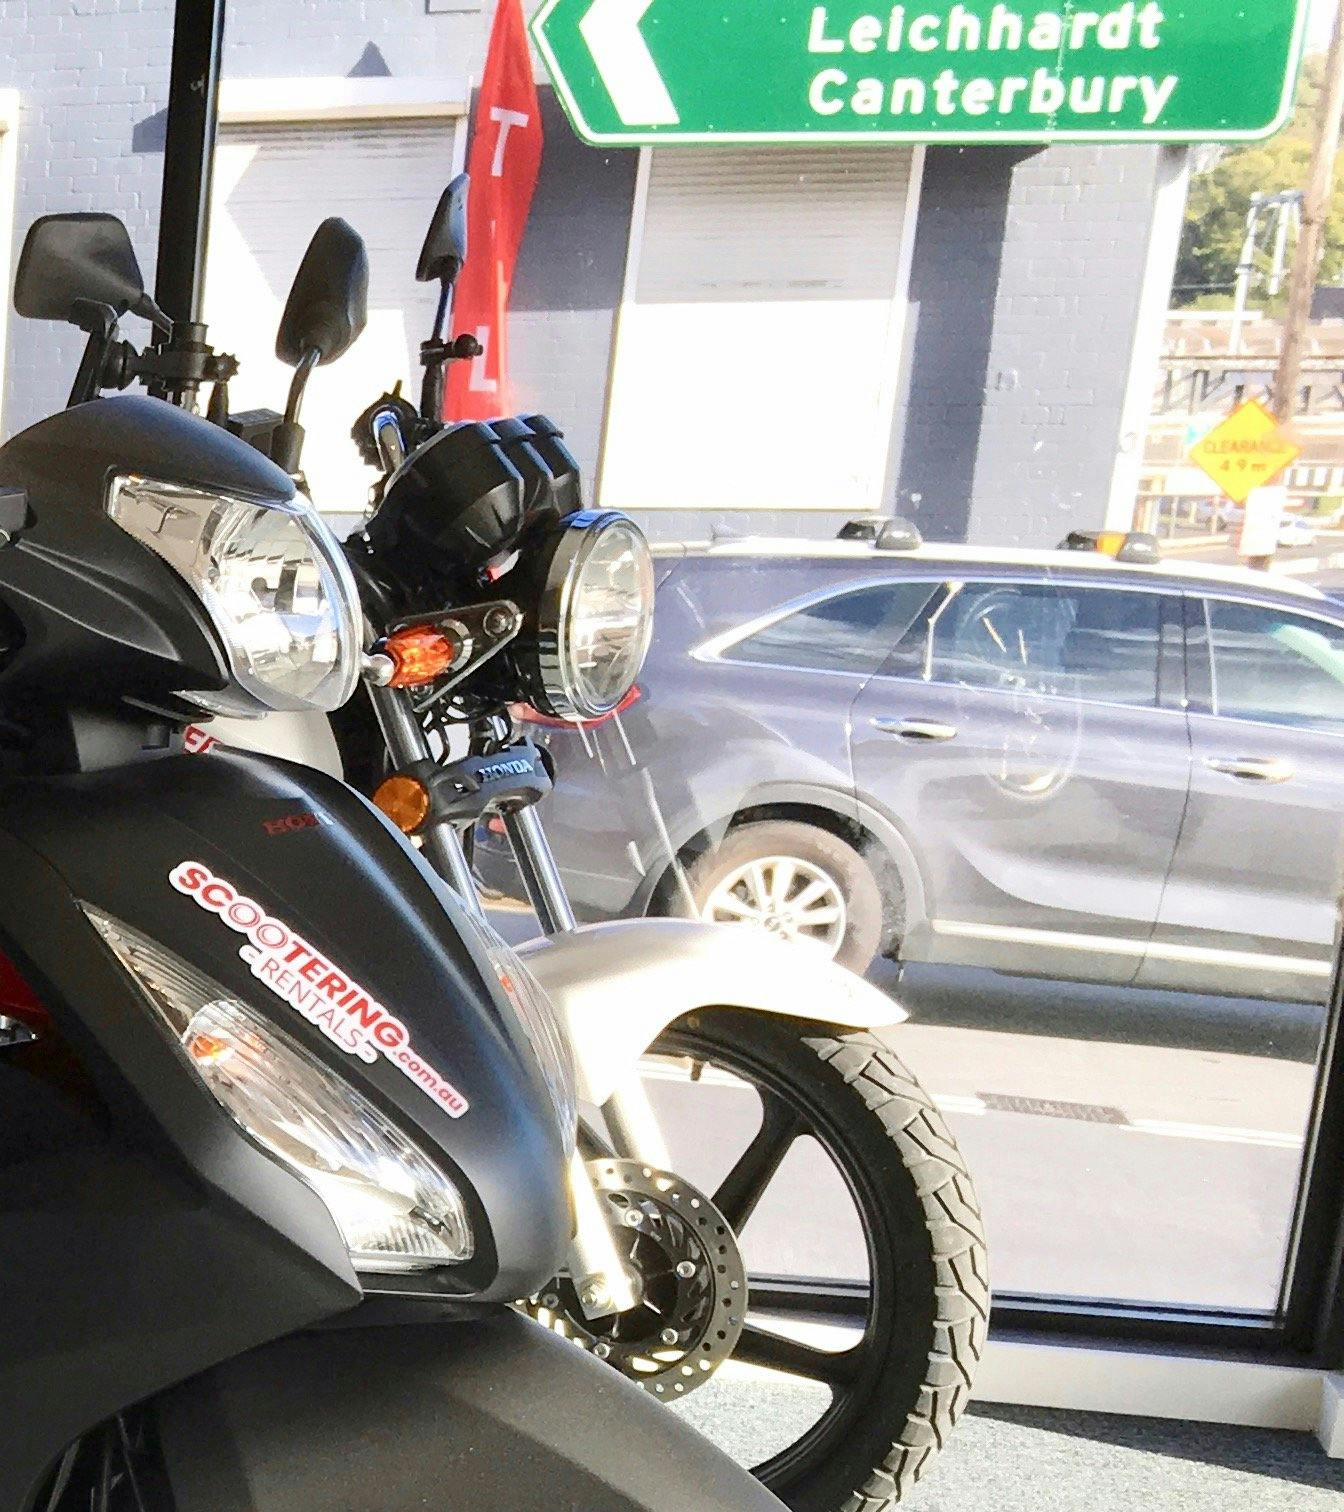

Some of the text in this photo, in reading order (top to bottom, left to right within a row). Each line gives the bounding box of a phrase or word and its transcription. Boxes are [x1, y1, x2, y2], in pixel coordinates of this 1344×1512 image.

[807, 1, 1165, 53] Leichhardt
[808, 67, 1179, 125] Canterbury
[479, 759, 534, 782] HONDA
[260, 956, 364, 1048] RENTALS
